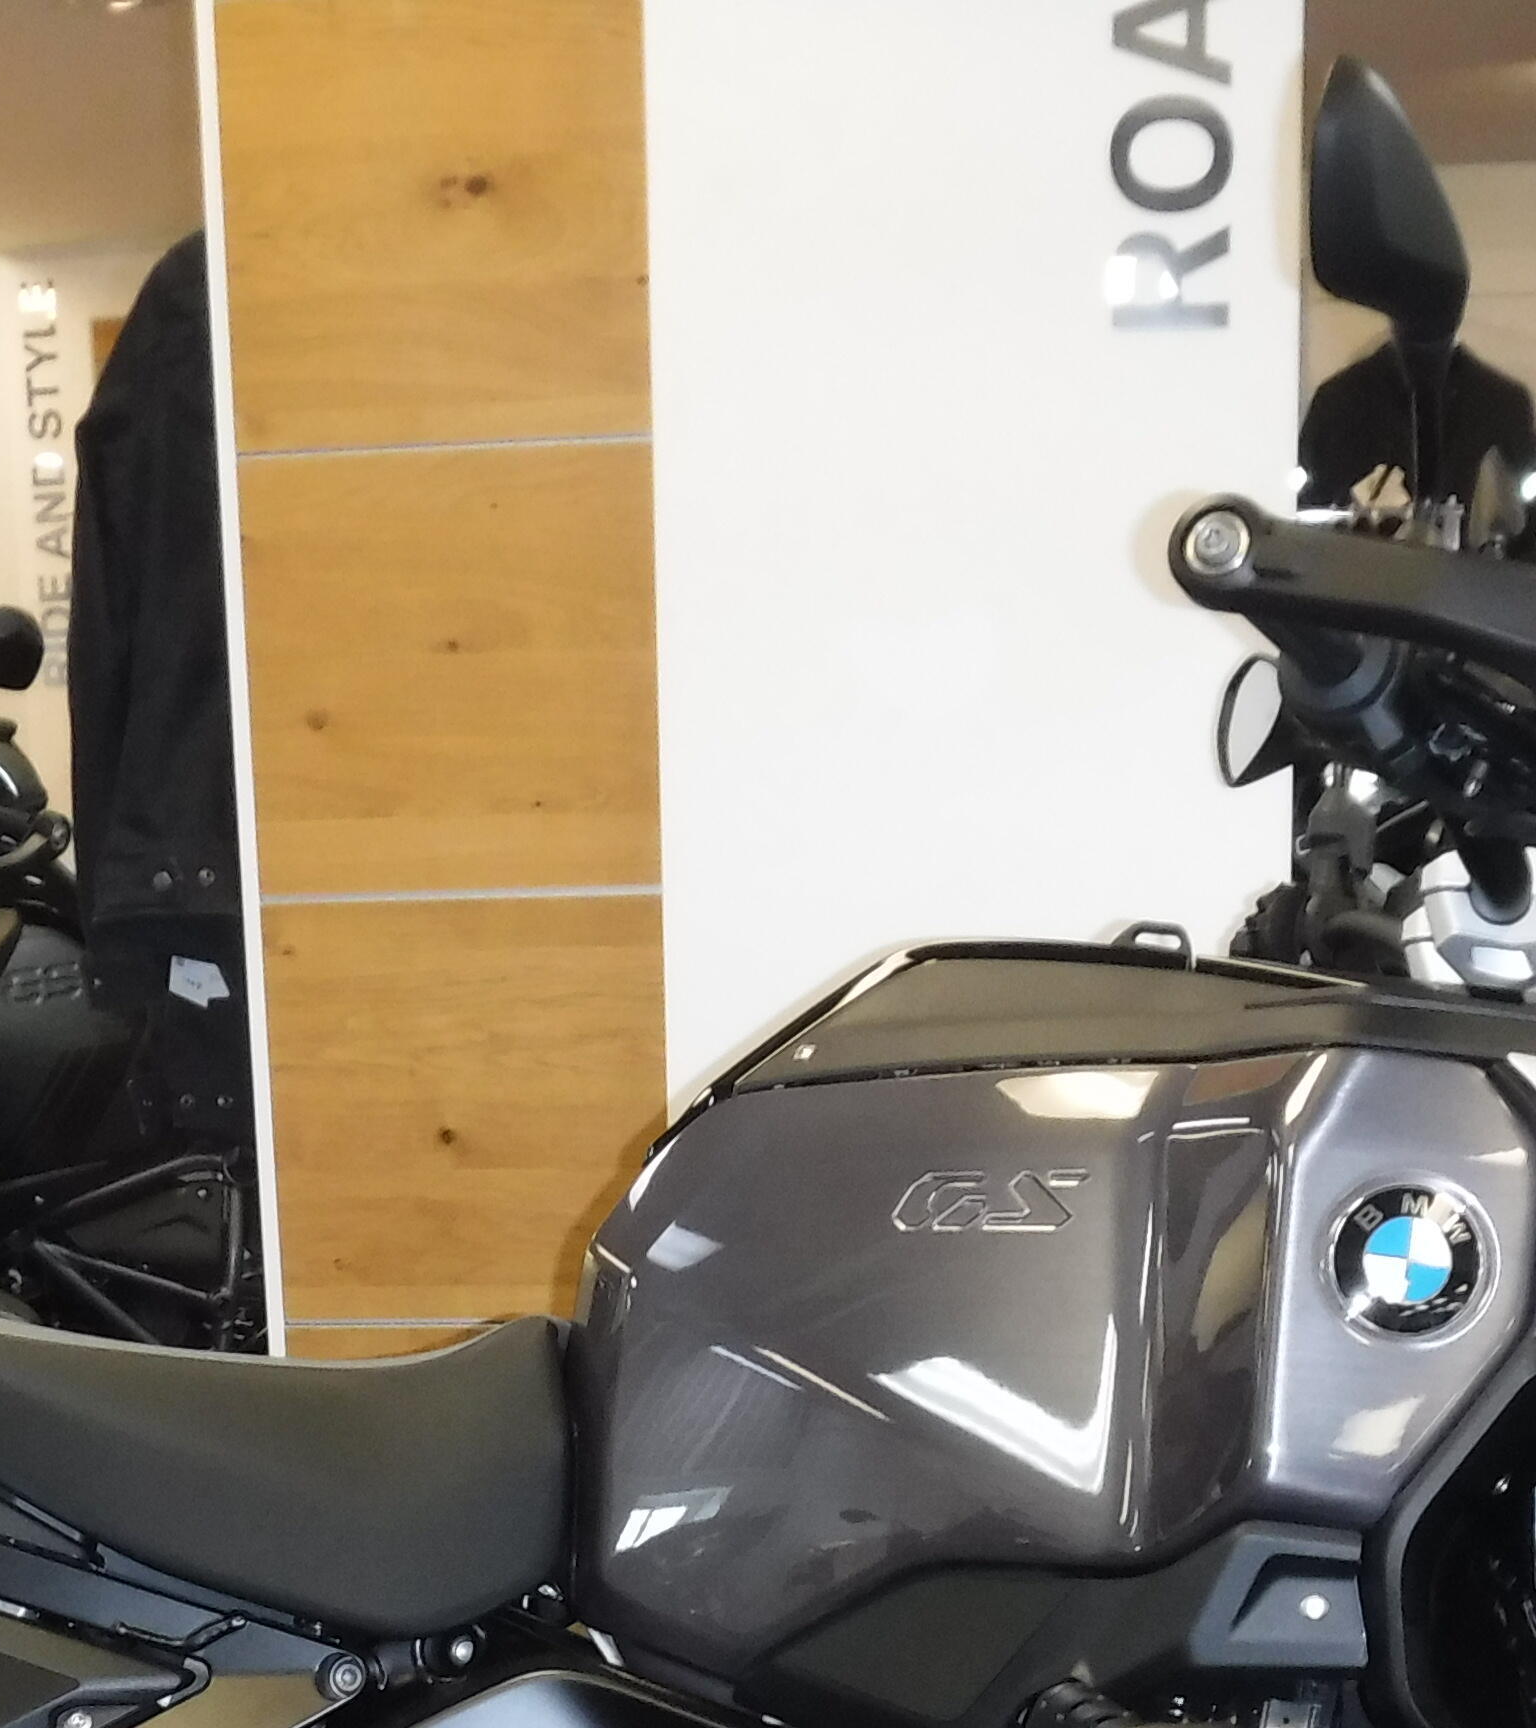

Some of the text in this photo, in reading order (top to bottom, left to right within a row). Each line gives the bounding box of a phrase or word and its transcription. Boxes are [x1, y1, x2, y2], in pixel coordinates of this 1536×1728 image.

[1109, 0, 1233, 328] ROA
[18, 278, 63, 440] STYLE
[32, 452, 72, 560] AND
[892, 1168, 1093, 1233] GS
[1353, 1191, 1472, 1246] BMW
